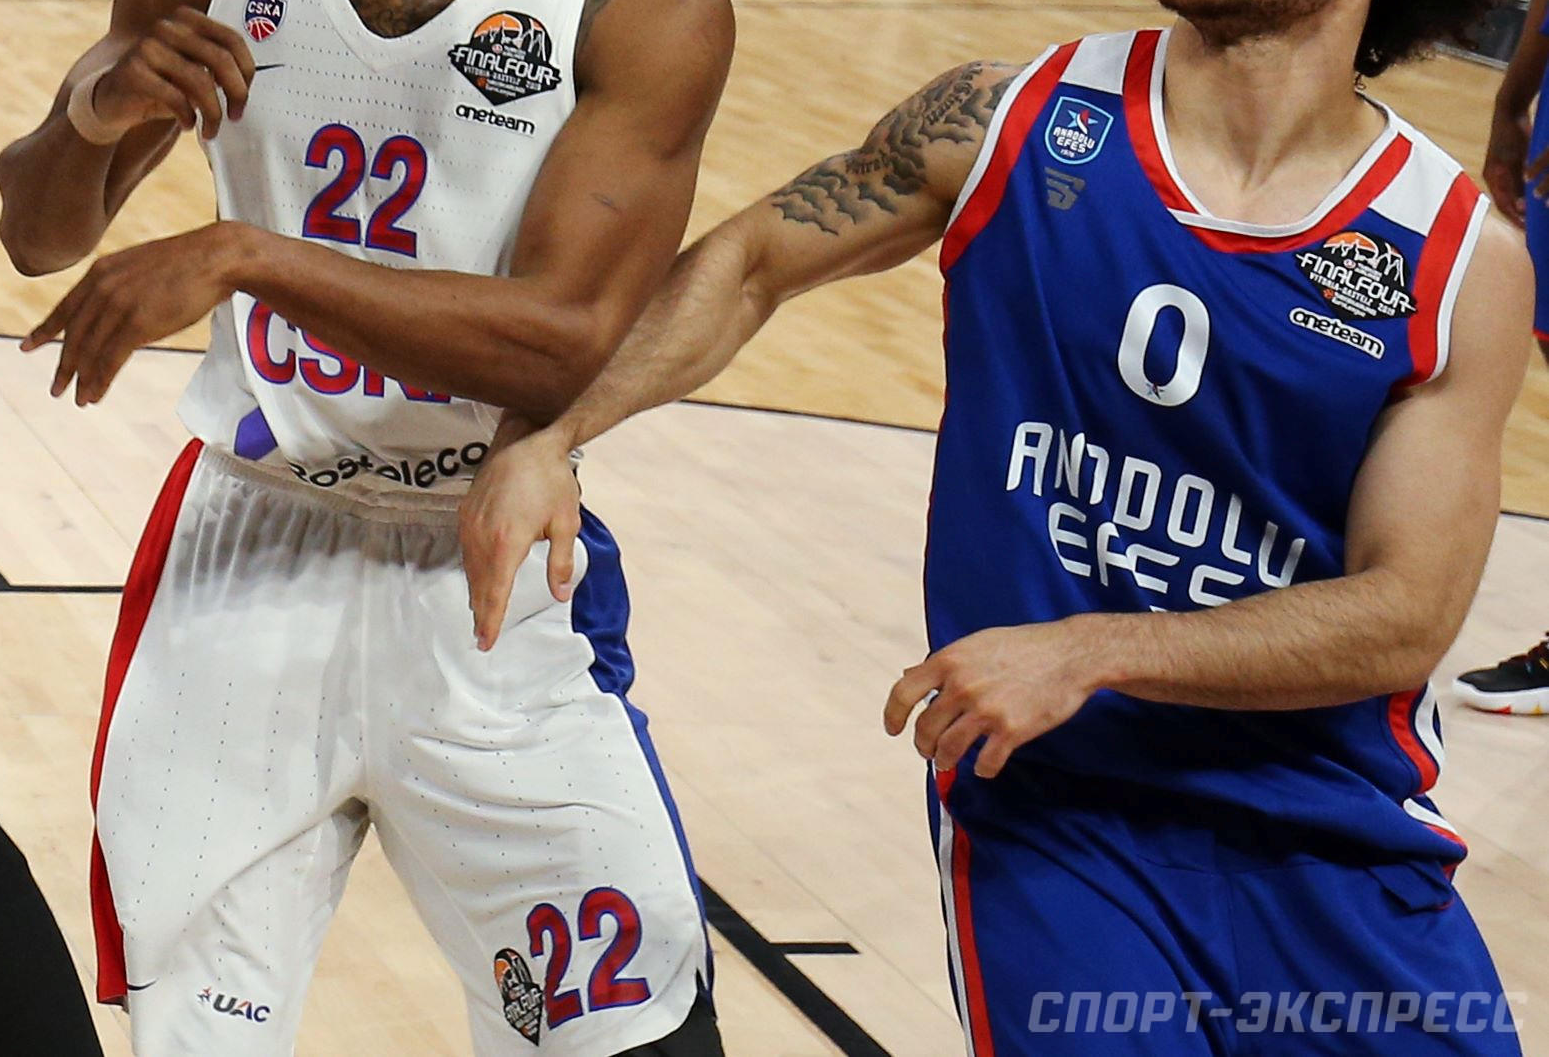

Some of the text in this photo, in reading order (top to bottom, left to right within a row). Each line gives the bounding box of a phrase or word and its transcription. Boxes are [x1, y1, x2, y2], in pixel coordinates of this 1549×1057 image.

[247, 1, 281, 17] CSKA
[454, 47, 554, 86] FINALFOUR
[456, 104, 535, 135] oneteam
[1053, 126, 1096, 149] ANADOLU
[1056, 136, 1086, 153] EFES
[302, 123, 428, 258] 22
[1300, 252, 1410, 313] FINALFOUR
[1117, 283, 1211, 407] 0
[1292, 310, 1383, 357] oneteam
[526, 886, 652, 1030] 22
[212, 993, 271, 1023] UAC
